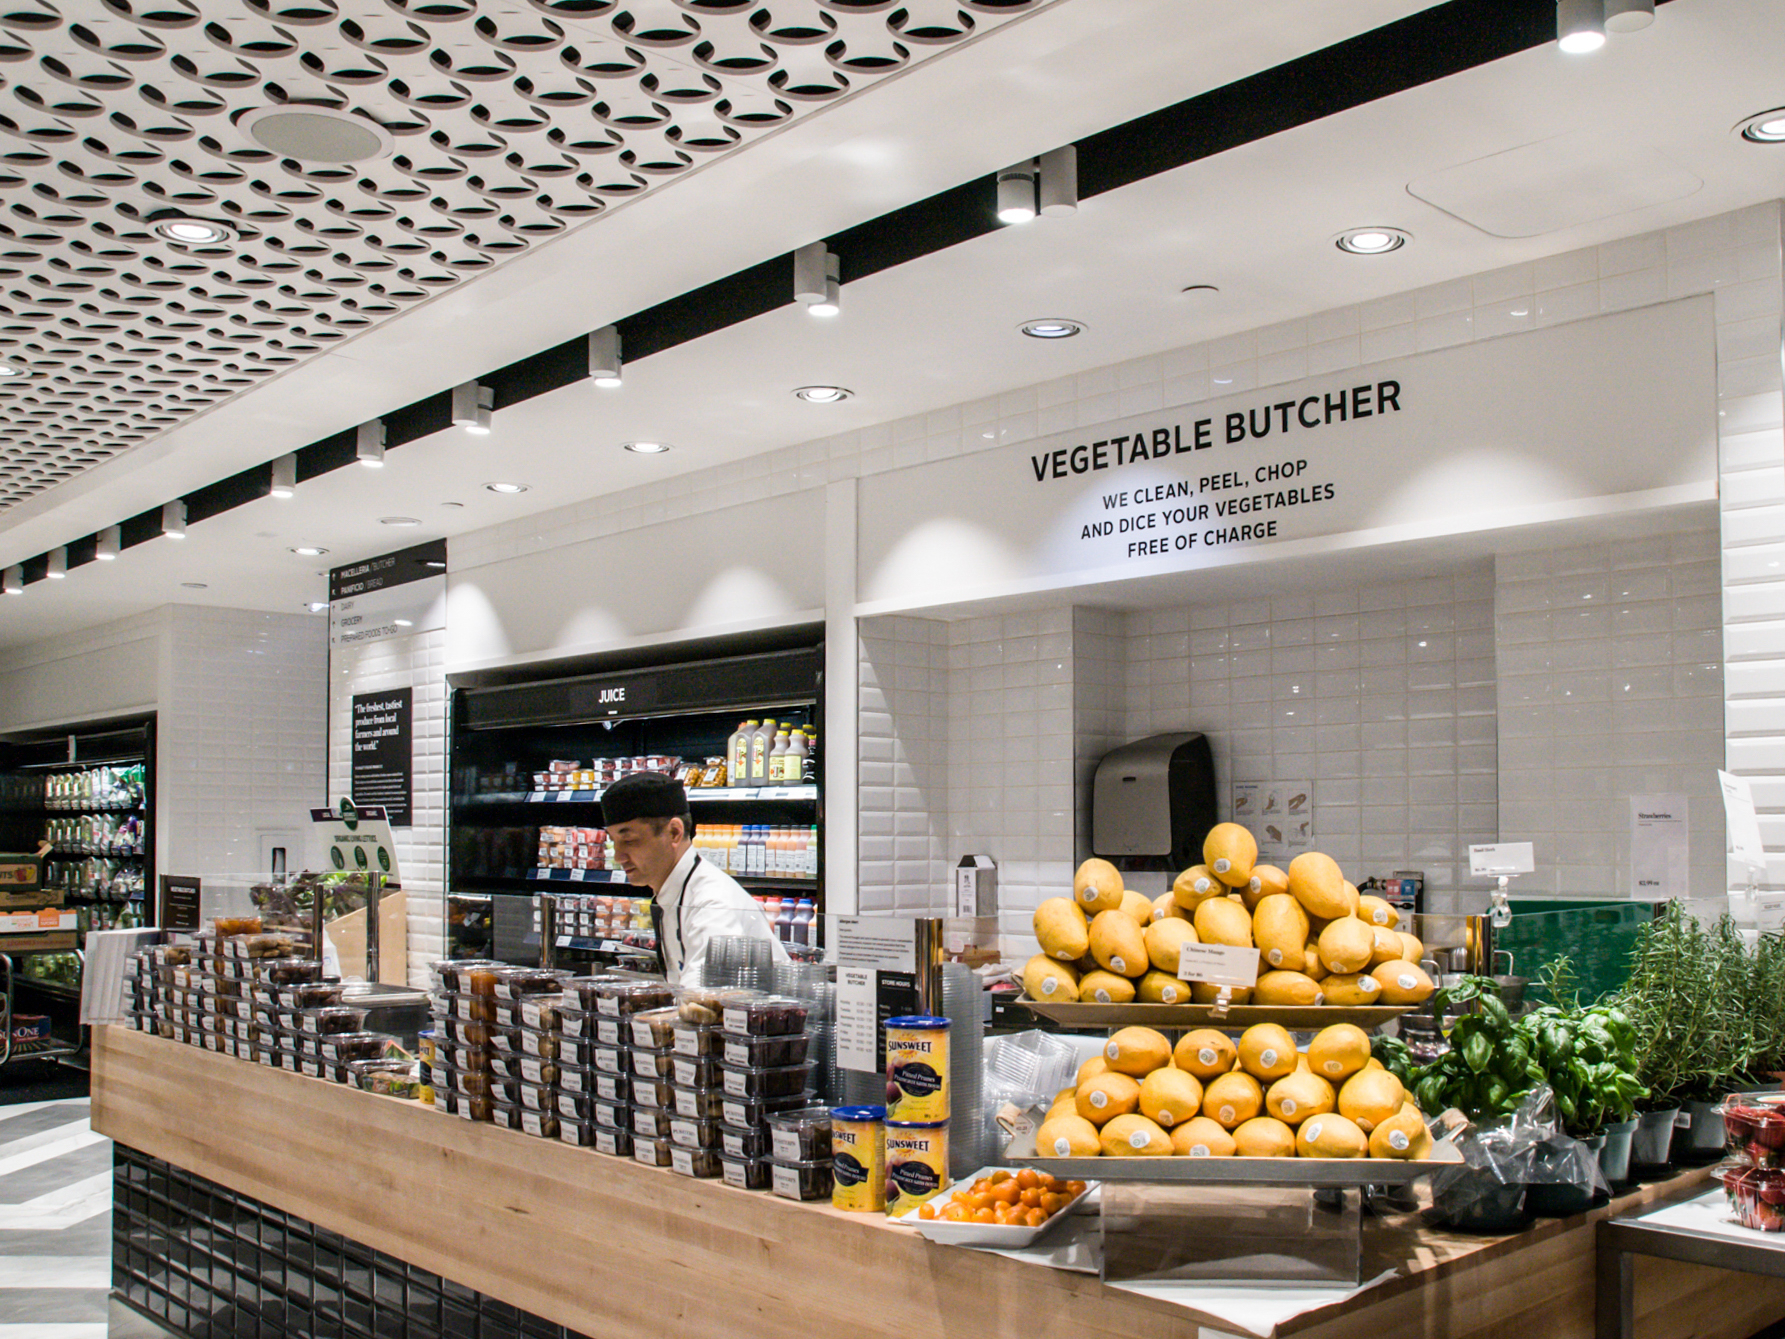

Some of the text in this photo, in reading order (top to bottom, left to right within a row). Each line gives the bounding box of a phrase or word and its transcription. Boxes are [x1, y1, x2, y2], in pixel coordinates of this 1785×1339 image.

[1031, 379, 1402, 482] VEGETABLE BUTCHER
[1103, 459, 1308, 510] WE CLEAN, PEEL, CHOP
[1081, 483, 1335, 540] AND DICE YOUR VEGETABLES
[1127, 520, 1277, 558] FREE OF CHARGE
[598, 687, 625, 703] JUICE
[374, 715, 385, 724] from
[385, 712, 397, 722] local
[888, 1040, 932, 1053] SUNSWEET
[918, 1073, 935, 1082] Prunes
[886, 1138, 930, 1152] SUNSWEET
